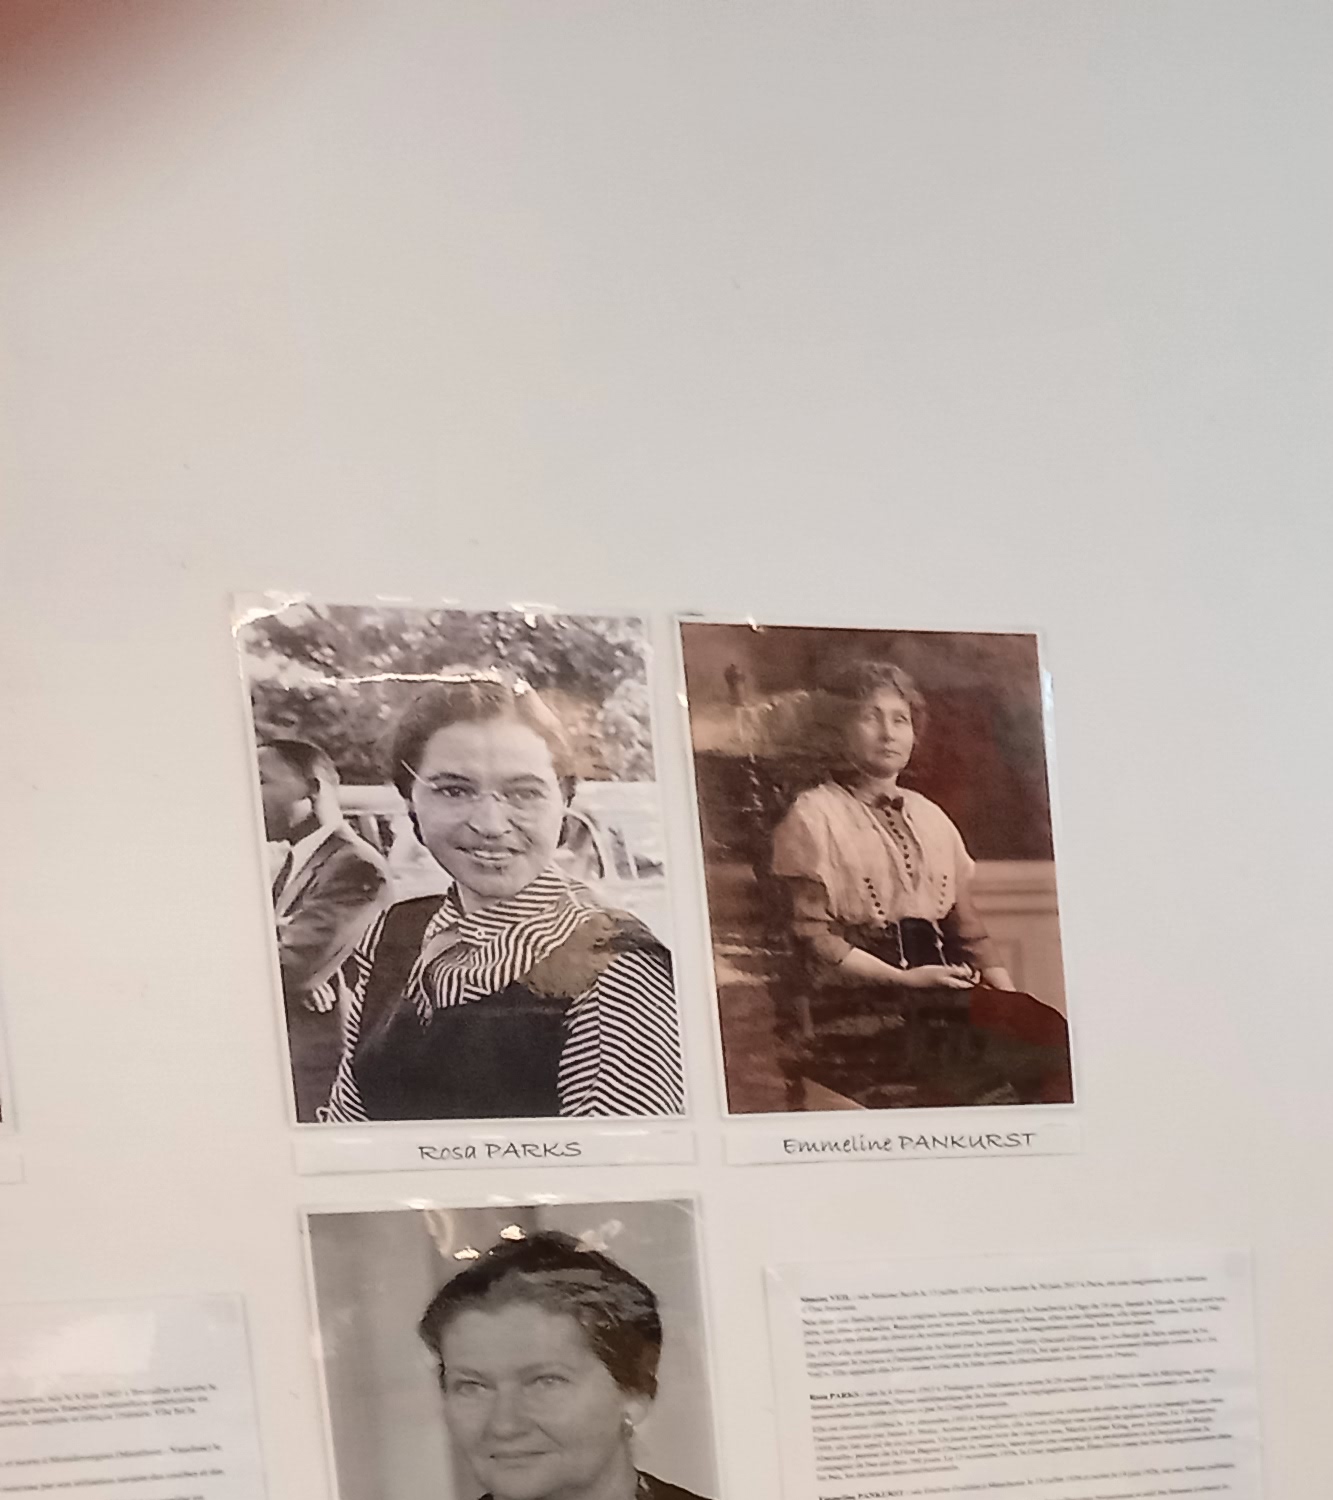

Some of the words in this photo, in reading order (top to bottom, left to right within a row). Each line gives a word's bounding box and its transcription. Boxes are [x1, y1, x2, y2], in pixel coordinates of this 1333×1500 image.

[418, 1145, 477, 1160] Rosa
[484, 1141, 583, 1159] PARKS
[783, 1134, 893, 1154] Emmeline
[897, 1132, 1037, 1150] PANKURST
